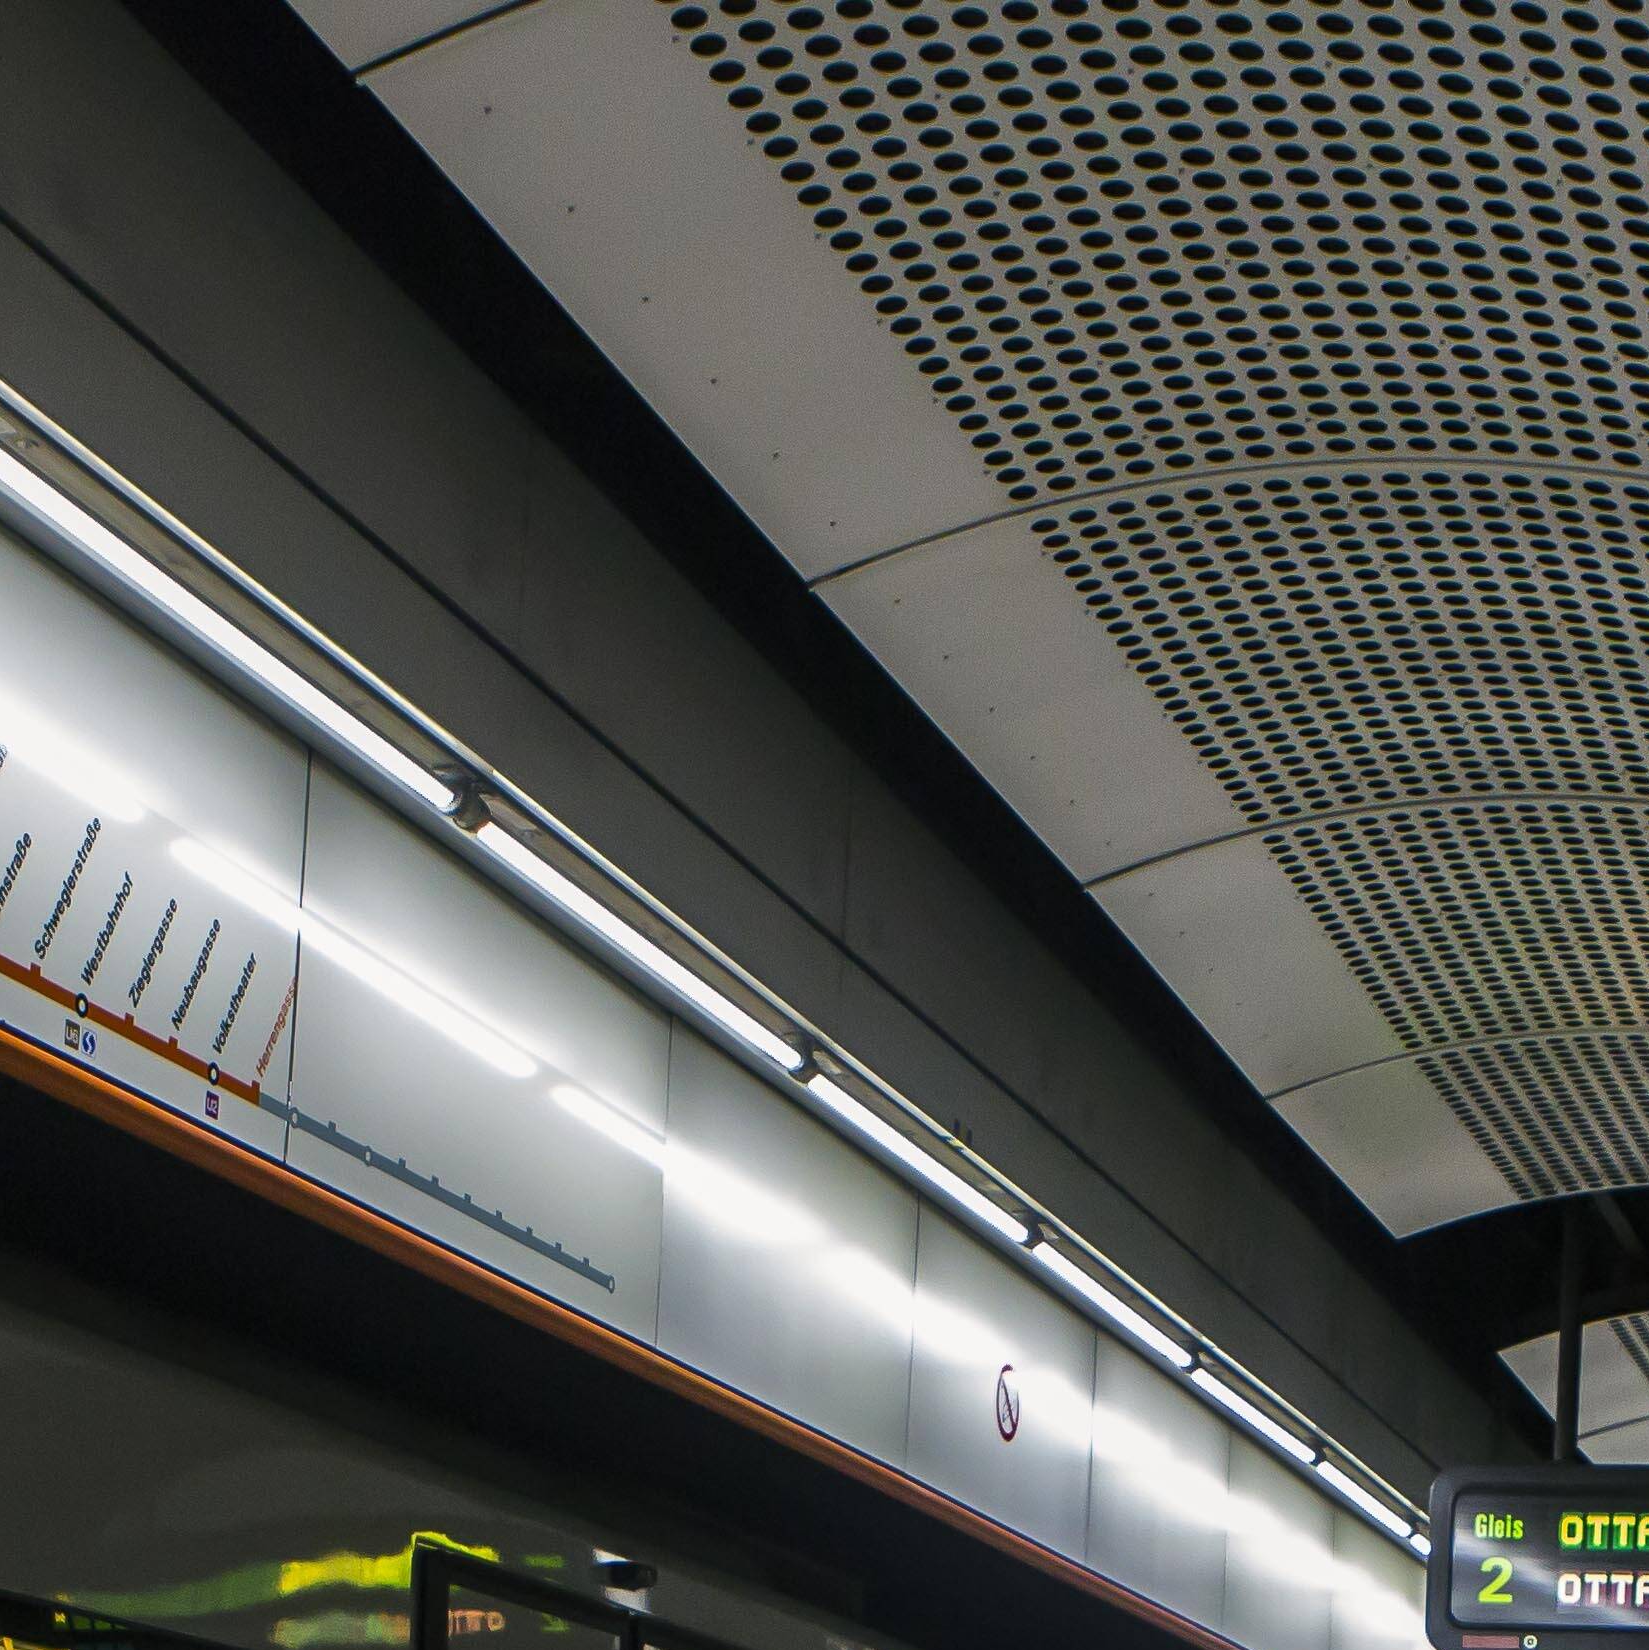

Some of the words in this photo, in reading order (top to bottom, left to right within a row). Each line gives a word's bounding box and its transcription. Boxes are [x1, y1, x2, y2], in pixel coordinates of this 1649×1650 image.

[34, 817, 101, 960] Schweglerstraße
[81, 871, 133, 986] Westbahnhof
[128, 898, 178, 1008] Zieglergasse
[171, 919, 221, 1031] Neubaugasse
[211, 952, 257, 1055] Volkstheater
[206, 1096, 218, 1115] U2
[1474, 1513, 1524, 1539] Gleis
[1478, 1556, 1514, 1604] 2
